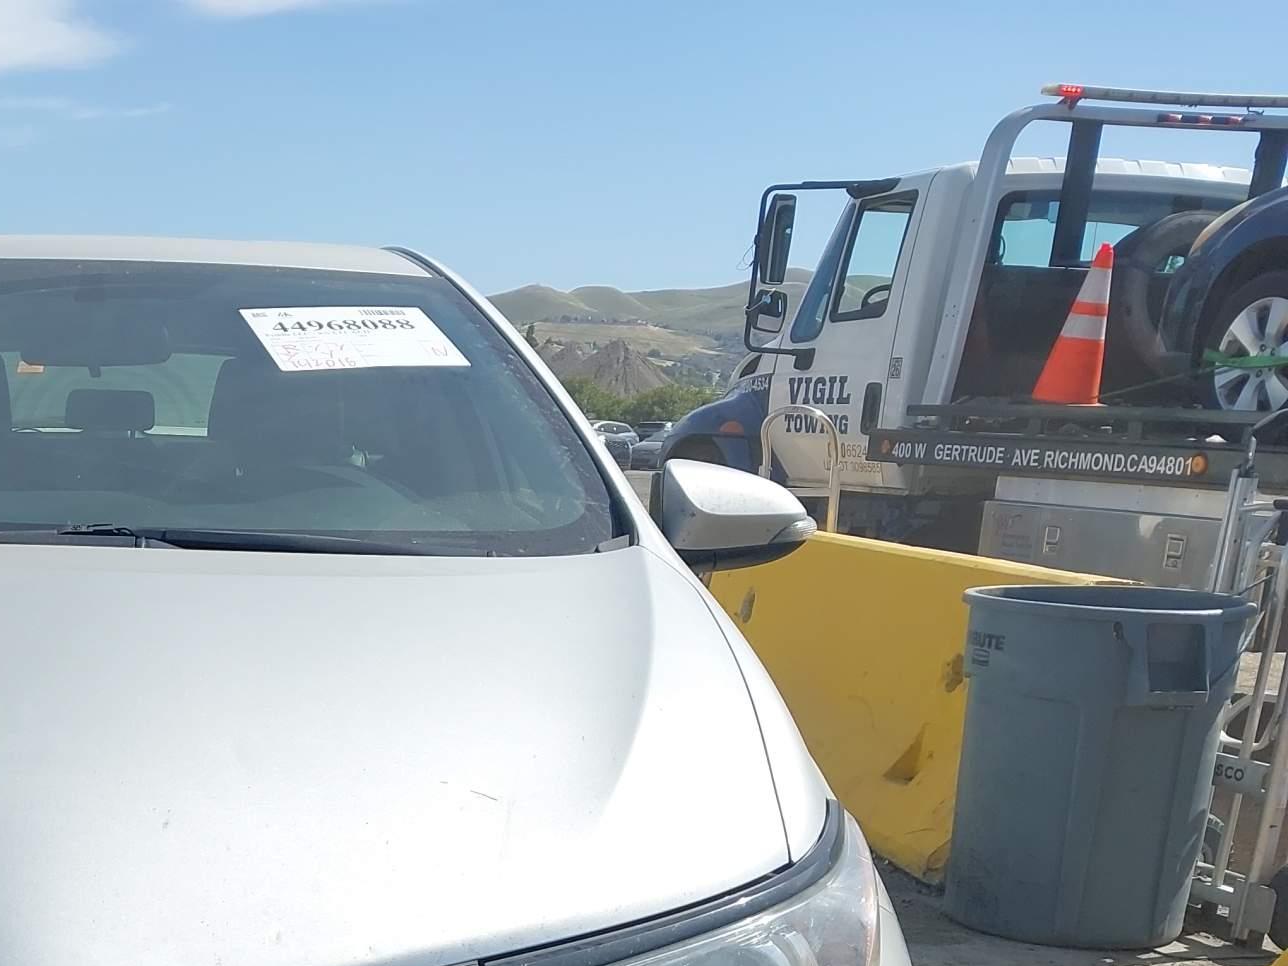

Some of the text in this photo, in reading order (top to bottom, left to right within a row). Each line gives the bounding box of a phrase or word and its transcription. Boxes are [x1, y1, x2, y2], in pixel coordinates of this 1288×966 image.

[272, 319, 416, 332] 44968088
[788, 375, 852, 405] VIGIL
[891, 442, 912, 459] 400
[914, 443, 928, 459] W
[934, 444, 1006, 464] GERTRUDE
